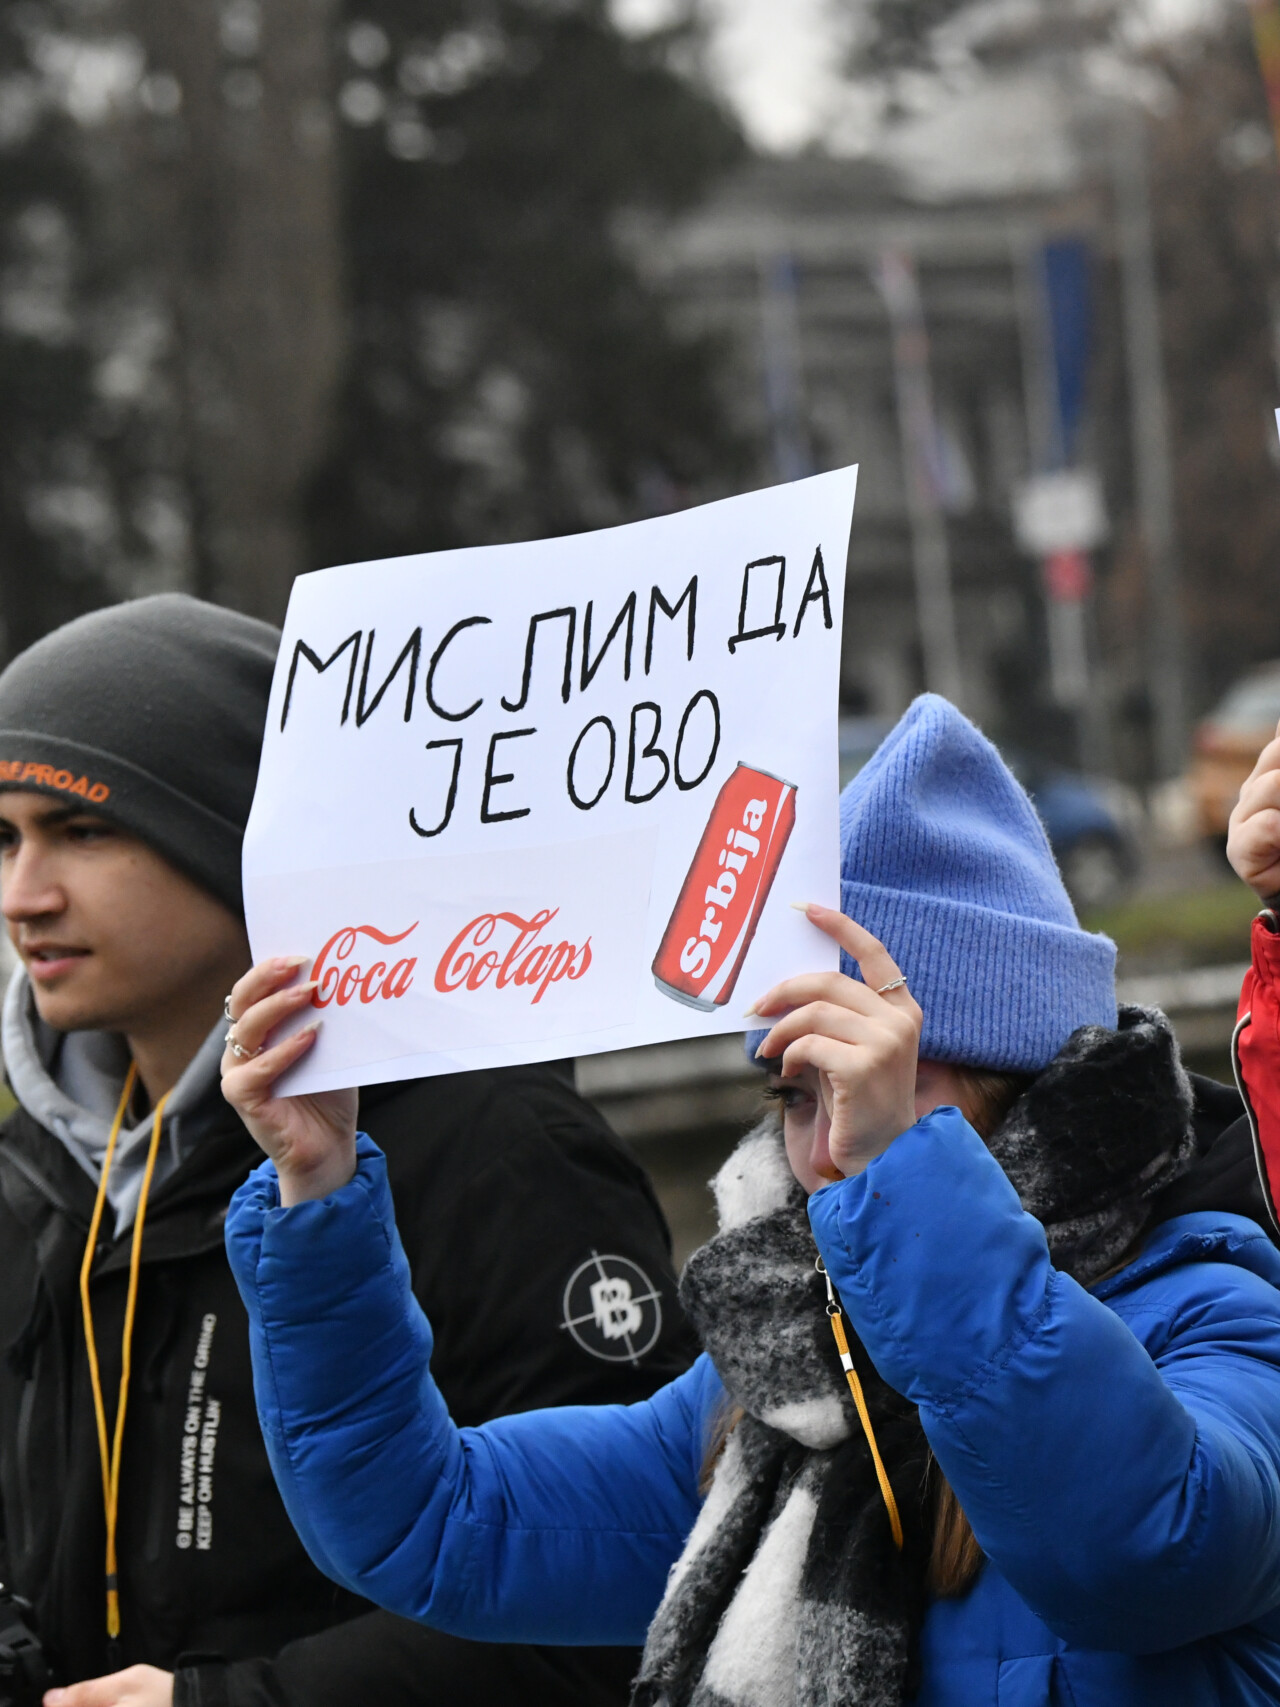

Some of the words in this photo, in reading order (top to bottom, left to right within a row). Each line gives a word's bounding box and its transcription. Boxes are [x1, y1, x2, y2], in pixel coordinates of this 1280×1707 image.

[280, 575, 698, 734] МИСЛИМ
[728, 545, 833, 655] ДА
[409, 727, 538, 838] ЈЕ
[566, 689, 721, 811] ОВО
[679, 797, 768, 979] Srbija
[310, 919, 420, 1010] Coca
[434, 906, 593, 1005] Colaps
[194, 1312, 217, 1369] GRIND
[188, 1369, 207, 1405] THE
[184, 1405, 202, 1434] ON
[180, 1434, 198, 1505] ALWAYS
[197, 1474, 212, 1503] ON
[177, 1506, 195, 1531] BE
[196, 1503, 212, 1550] KEEP
